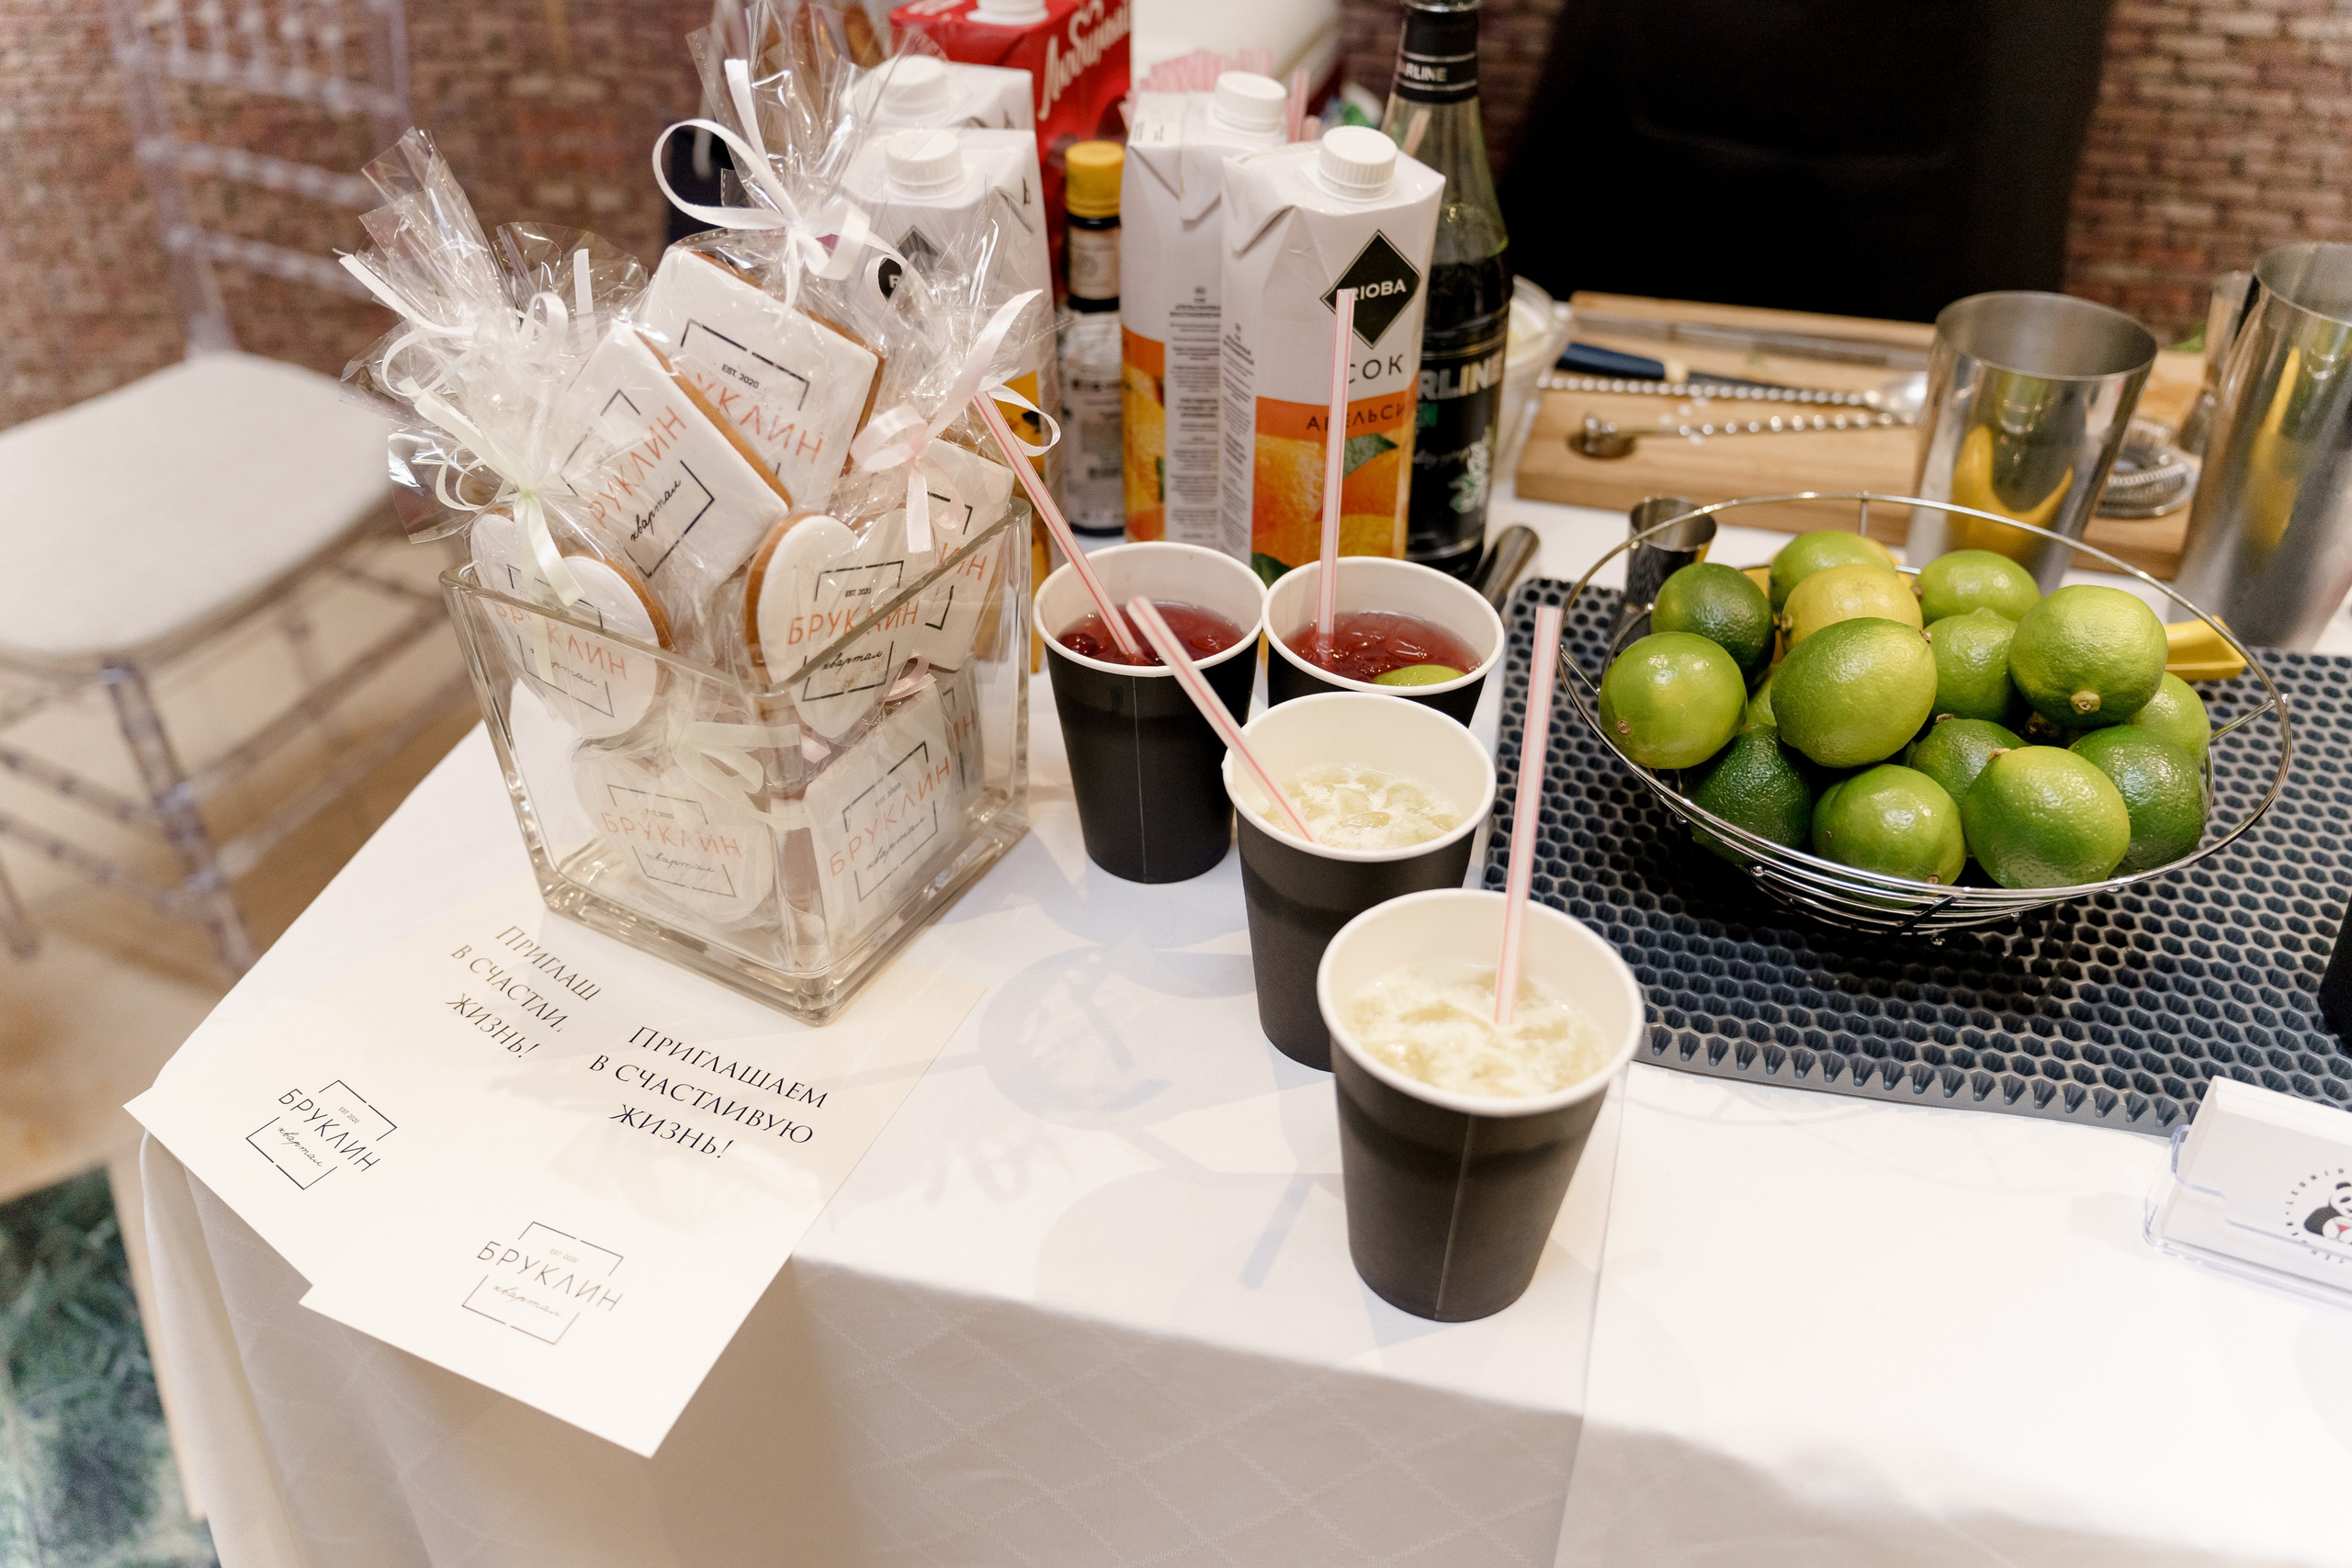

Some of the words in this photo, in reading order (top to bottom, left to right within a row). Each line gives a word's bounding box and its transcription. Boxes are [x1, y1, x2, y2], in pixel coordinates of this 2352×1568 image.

[739, 374, 760, 389] 2020
[493, 591, 628, 681] БРКЛИН
[829, 756, 950, 877] БРУКЛИН
[445, 992, 540, 1058] ЖИЗНЬ!
[451, 944, 472, 960] В
[469, 957, 569, 1032] СЧАСТЛИ
[589, 1054, 610, 1072] В
[615, 1064, 813, 1144] СЧАСТЛИВУЮ
[628, 1025, 829, 1110] ПРИГЛАШАЕМ
[278, 1089, 380, 1172] БРУКЛИН
[346, 1113, 360, 1124] 2020
[607, 1102, 735, 1159] ЖИЗНЬ!
[477, 1240, 623, 1312] БРУКЛИН
